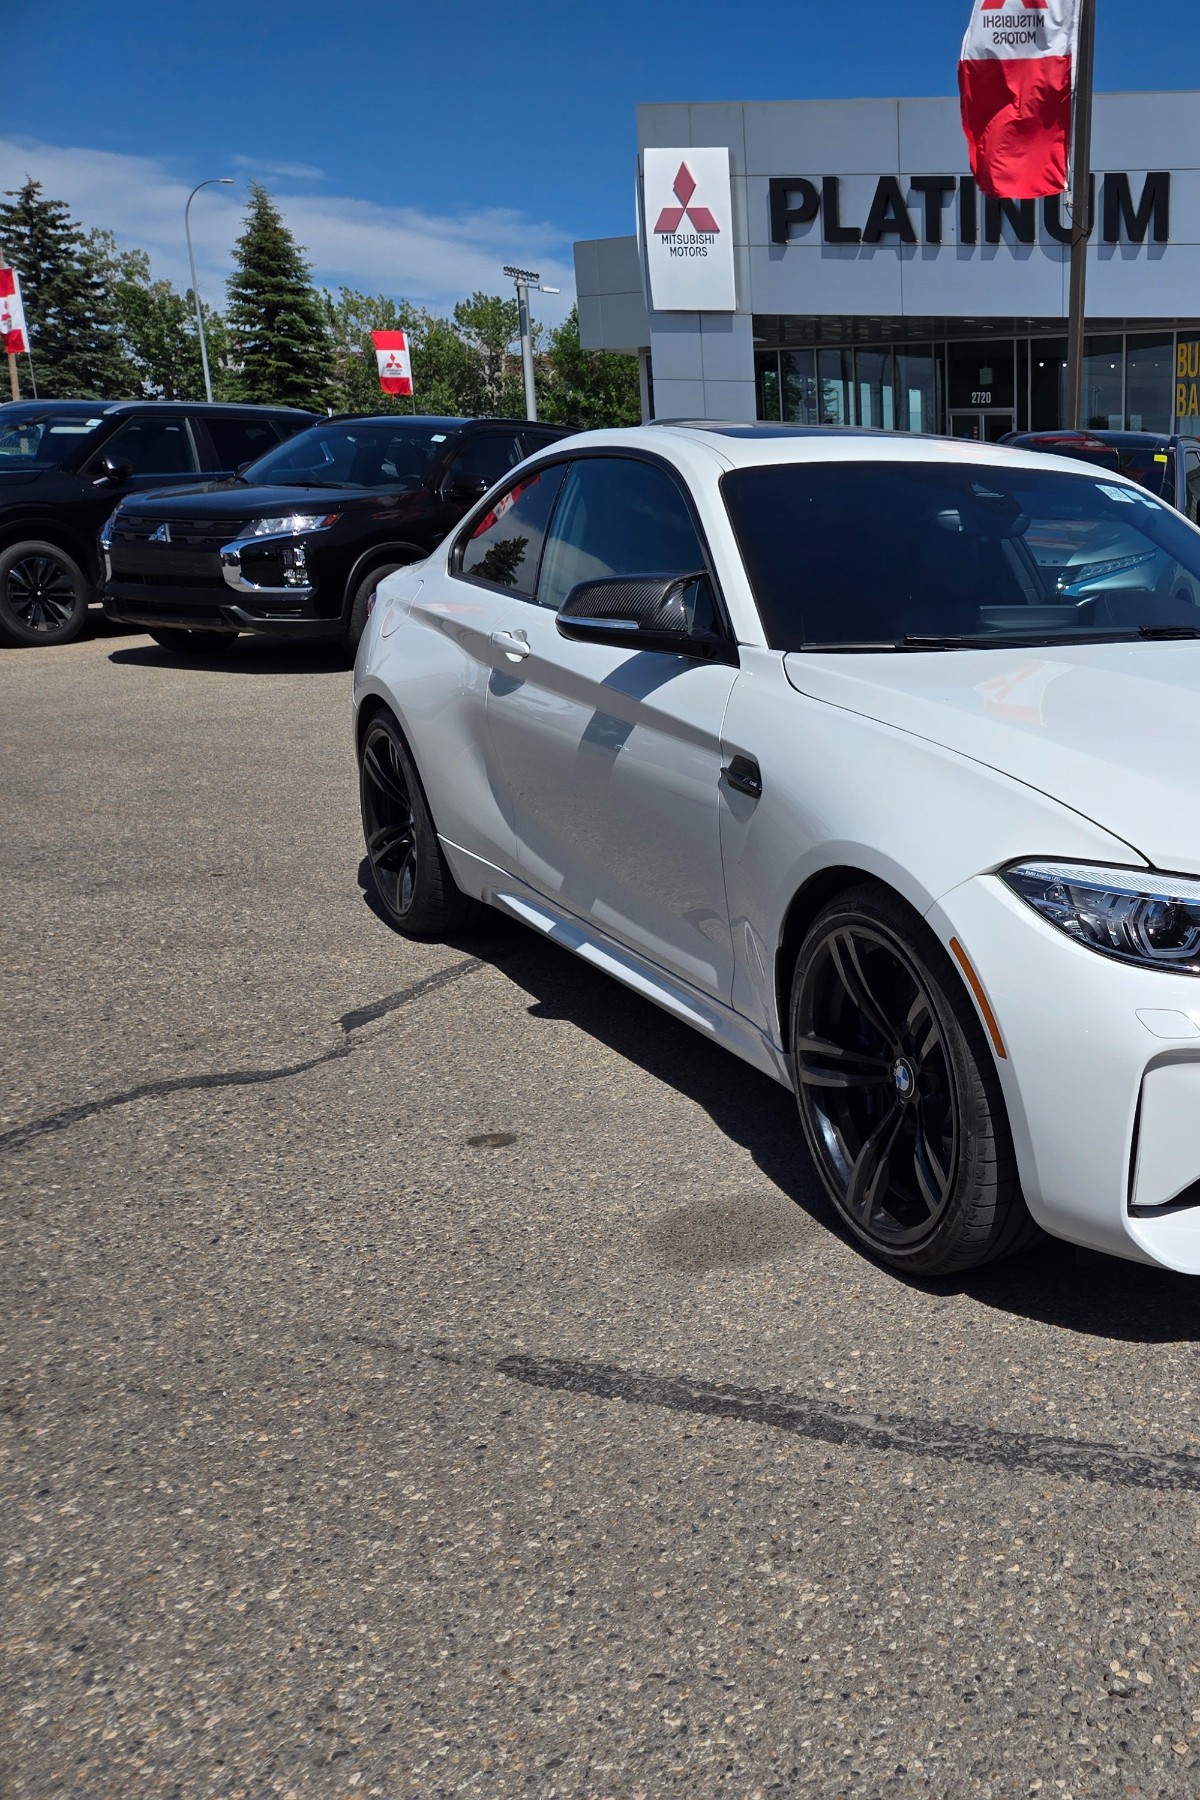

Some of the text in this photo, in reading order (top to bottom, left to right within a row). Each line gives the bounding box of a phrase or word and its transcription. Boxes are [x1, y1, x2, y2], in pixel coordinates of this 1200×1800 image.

[769, 172, 1171, 244] PLATINUM
[661, 234, 715, 244] MITSUBISHI
[669, 246, 708, 257] MOTORS
[971, 391, 992, 404] 2720
